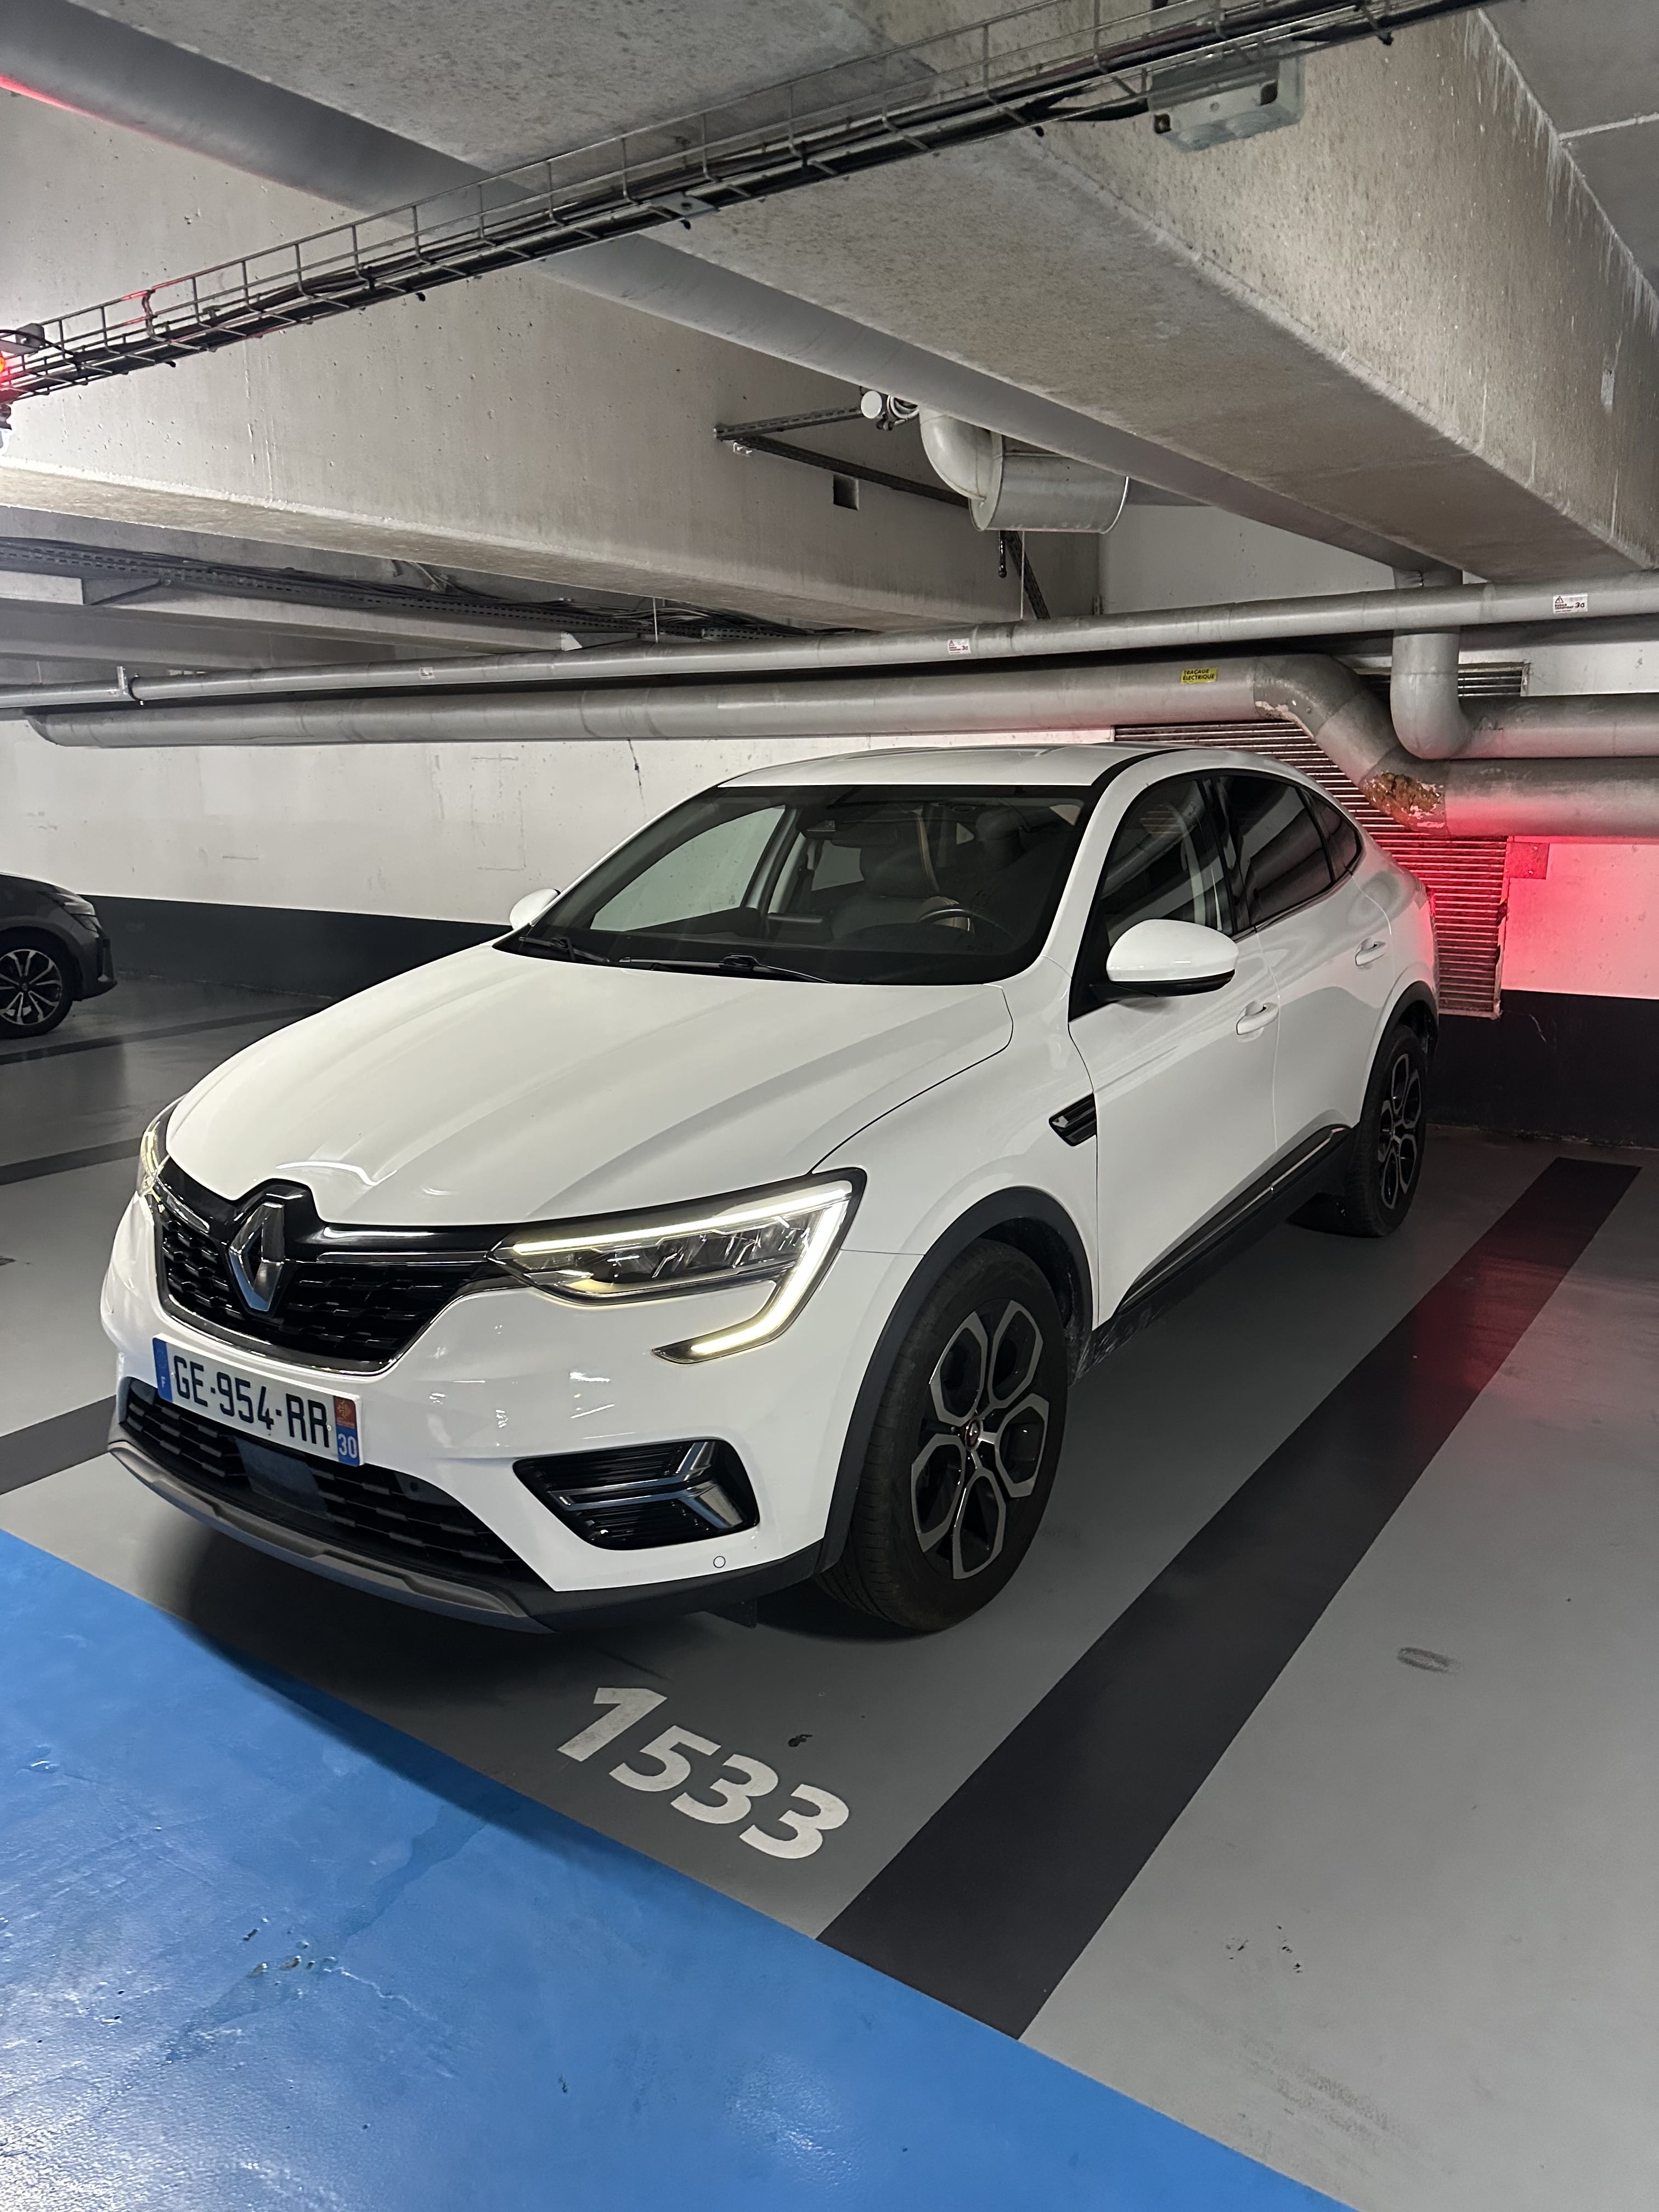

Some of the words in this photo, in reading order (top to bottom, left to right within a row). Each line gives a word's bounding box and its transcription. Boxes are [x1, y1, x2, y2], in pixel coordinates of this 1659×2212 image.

[161, 1376, 166, 1388] F
[173, 1355, 329, 1448] GE-954-RR
[338, 1433, 358, 1458] 30
[557, 1688, 849, 1859] 1533
